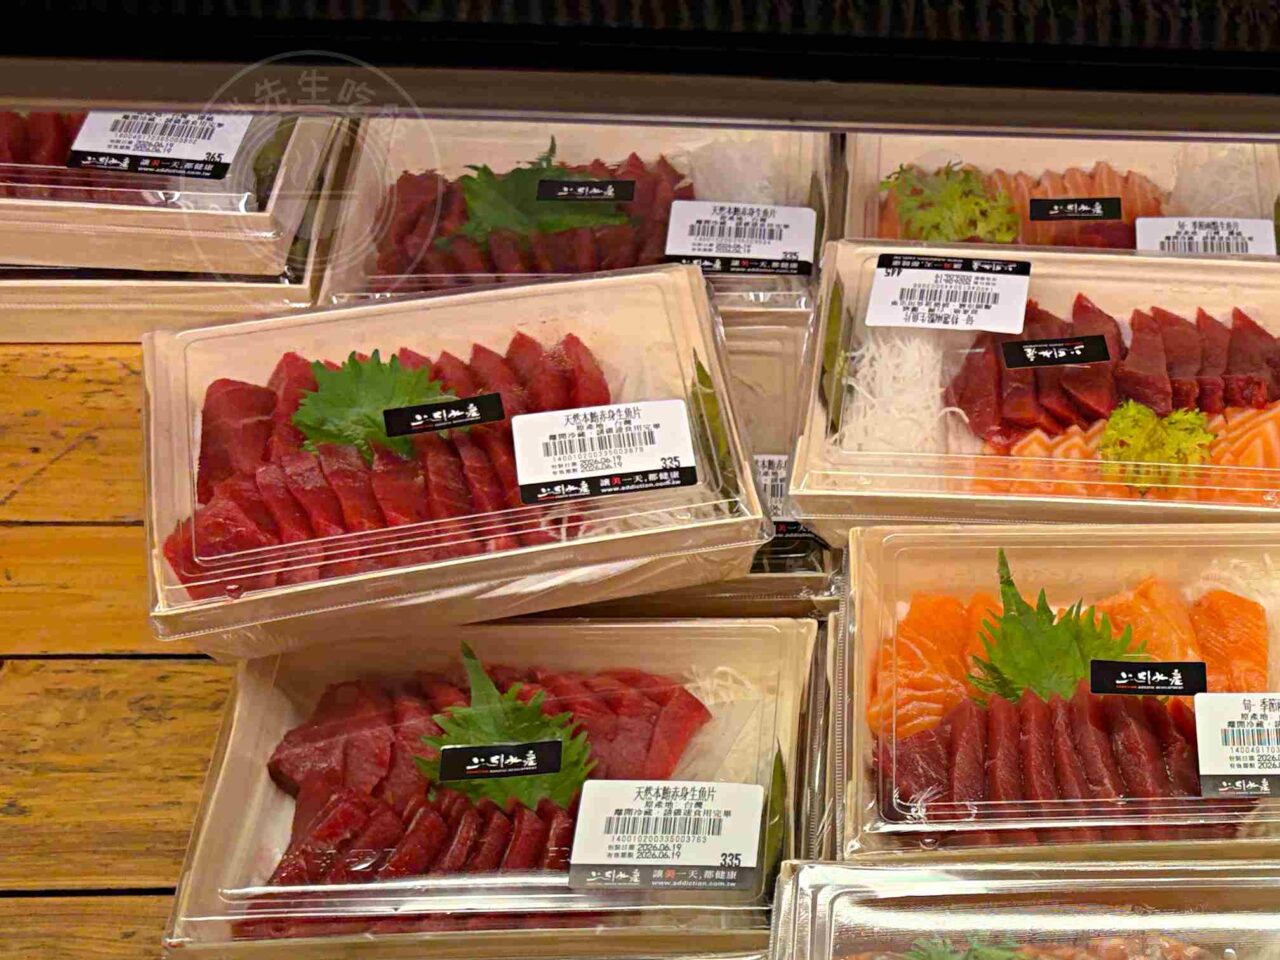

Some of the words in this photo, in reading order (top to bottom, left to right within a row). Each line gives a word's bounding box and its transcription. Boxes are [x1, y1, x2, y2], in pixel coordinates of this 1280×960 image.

[203, 153, 224, 163] 365
[660, 456, 680, 469] 335
[720, 853, 742, 867] 335
